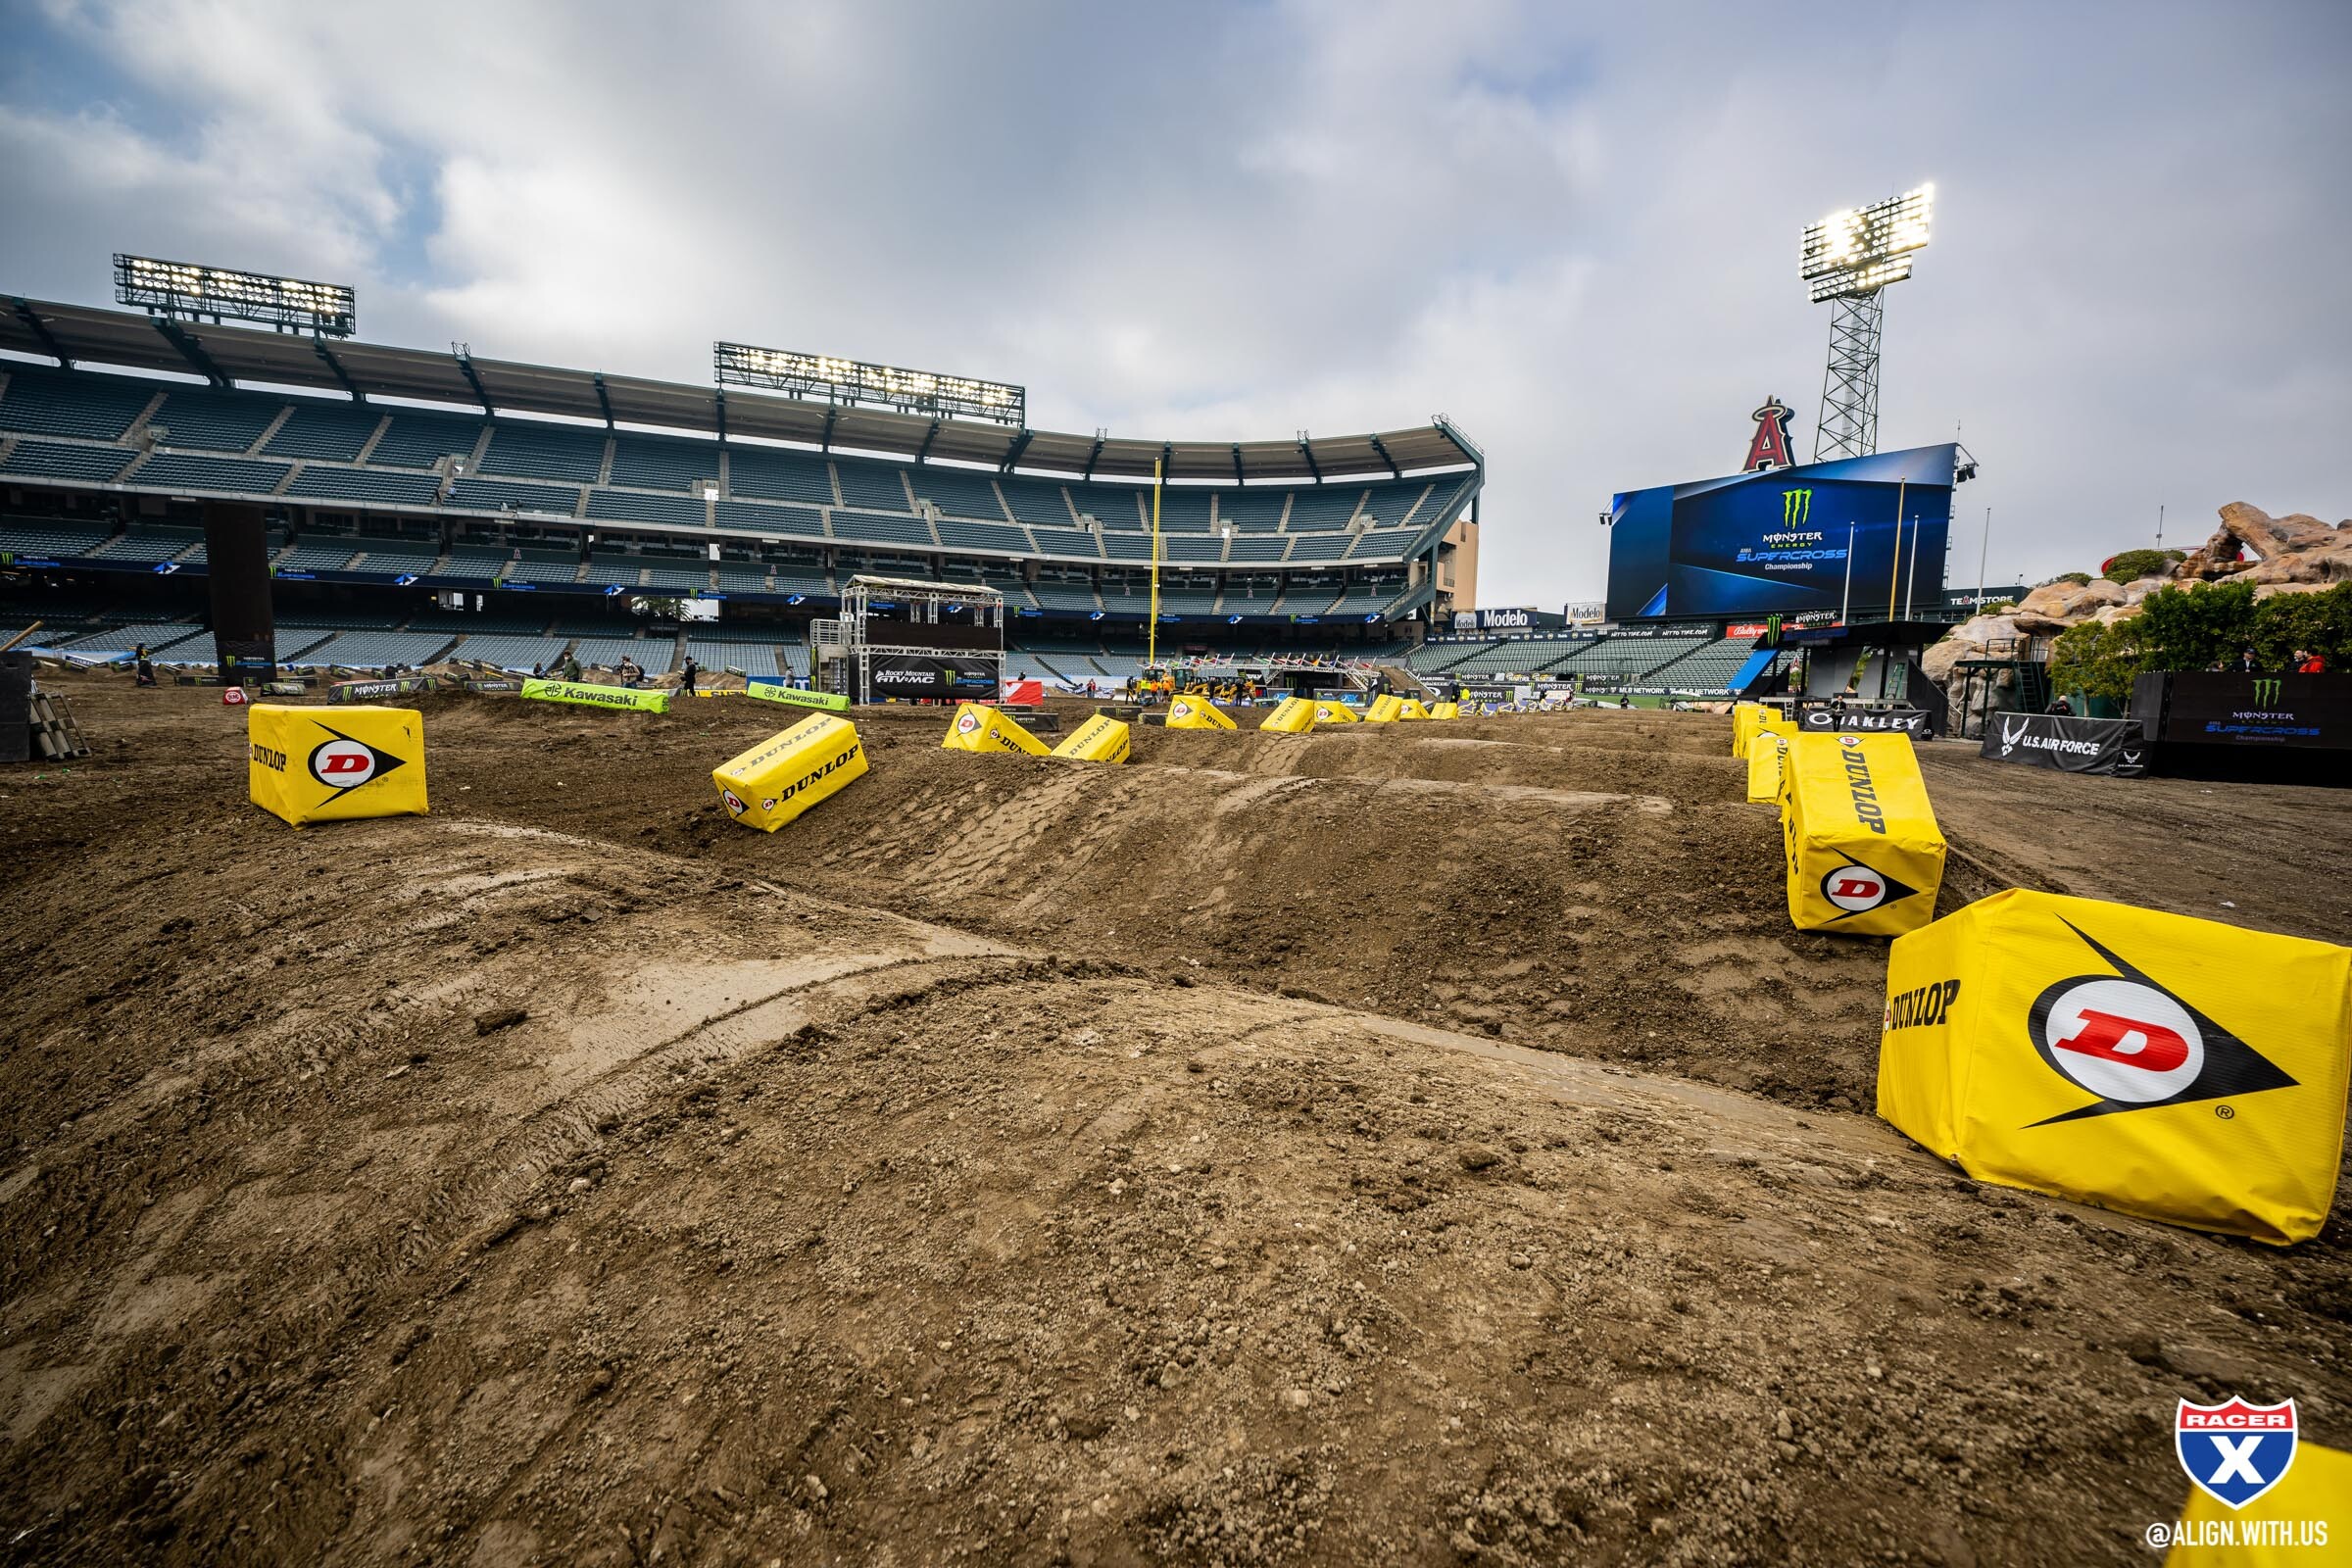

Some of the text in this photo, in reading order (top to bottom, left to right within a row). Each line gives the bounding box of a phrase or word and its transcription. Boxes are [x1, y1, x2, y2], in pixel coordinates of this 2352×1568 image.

[1763, 531, 1823, 543] MONSTER
[1736, 549, 1848, 563] SUPERCROSS
[1950, 594, 1978, 606] TEAM
[1483, 609, 1528, 627] Modelo
[1572, 608, 1600, 618] Modelo
[1734, 625, 1757, 636] Bally
[354, 683, 397, 695] MONSTER
[564, 687, 638, 707] Kawasaki
[777, 690, 829, 706] Kawasaki
[1206, 714, 1228, 729] DUN
[1840, 715, 1921, 730] AKLEY
[2232, 710, 2295, 720] MONSTER
[750, 716, 832, 767] DUNLOP
[1000, 735, 1033, 757] DUN
[2059, 739, 2101, 756] FORCE
[253, 743, 287, 772] DUNLOP
[320, 754, 369, 774] D
[781, 744, 858, 803] DUNLOP
[1841, 749, 1886, 835] DUNLOP
[1831, 878, 1881, 899] D
[1891, 978, 1961, 1031] DUNLOP
[2054, 1007, 2189, 1072] D
